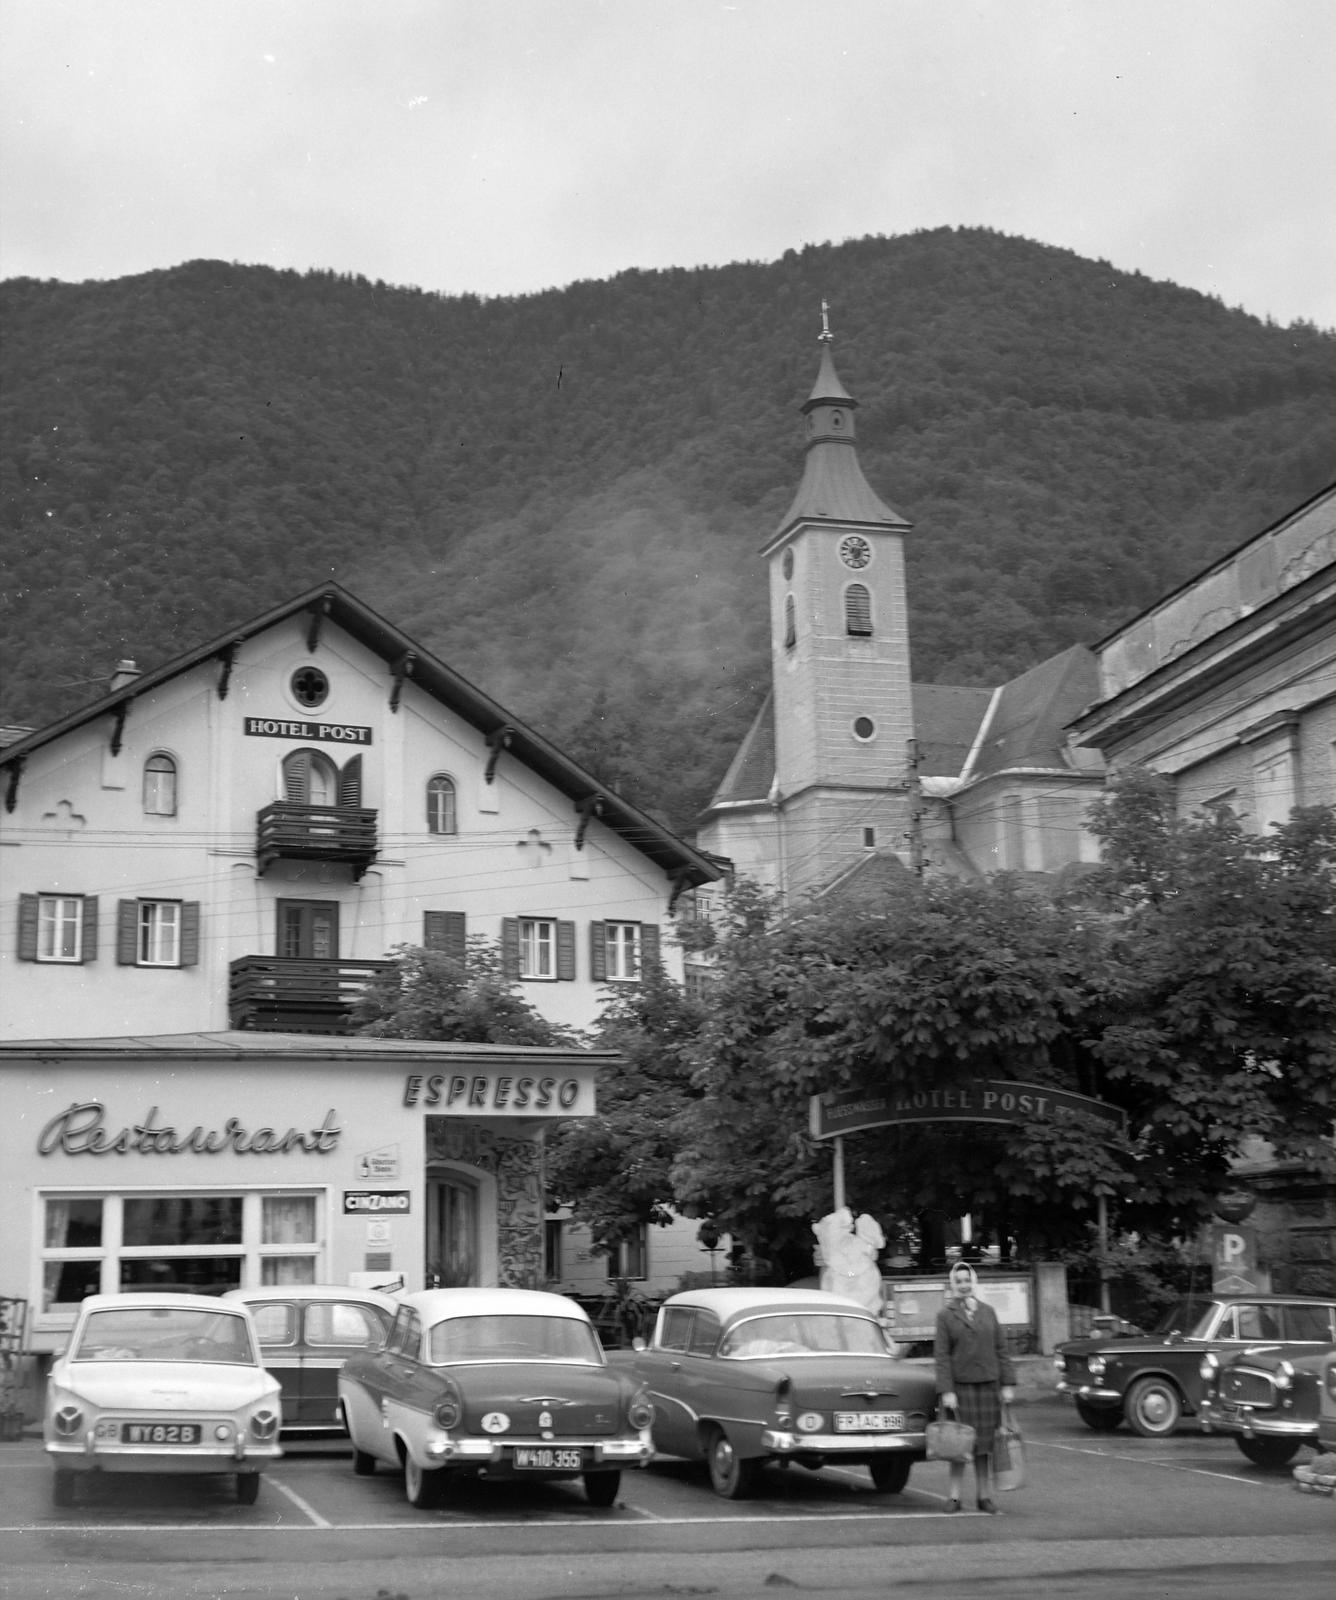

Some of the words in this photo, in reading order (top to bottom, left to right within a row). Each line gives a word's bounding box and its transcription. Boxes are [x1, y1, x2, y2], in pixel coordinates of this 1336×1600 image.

[249, 719, 315, 737] HOTEL
[318, 725, 369, 741] POST
[403, 1075, 580, 1107] ESPRESSO
[983, 1091, 1049, 1115] POST
[37, 1102, 342, 1156] Restaurant
[345, 1195, 409, 1210] CINZANO
[1223, 1233, 1246, 1263] P
[490, 1415, 501, 1428] A
